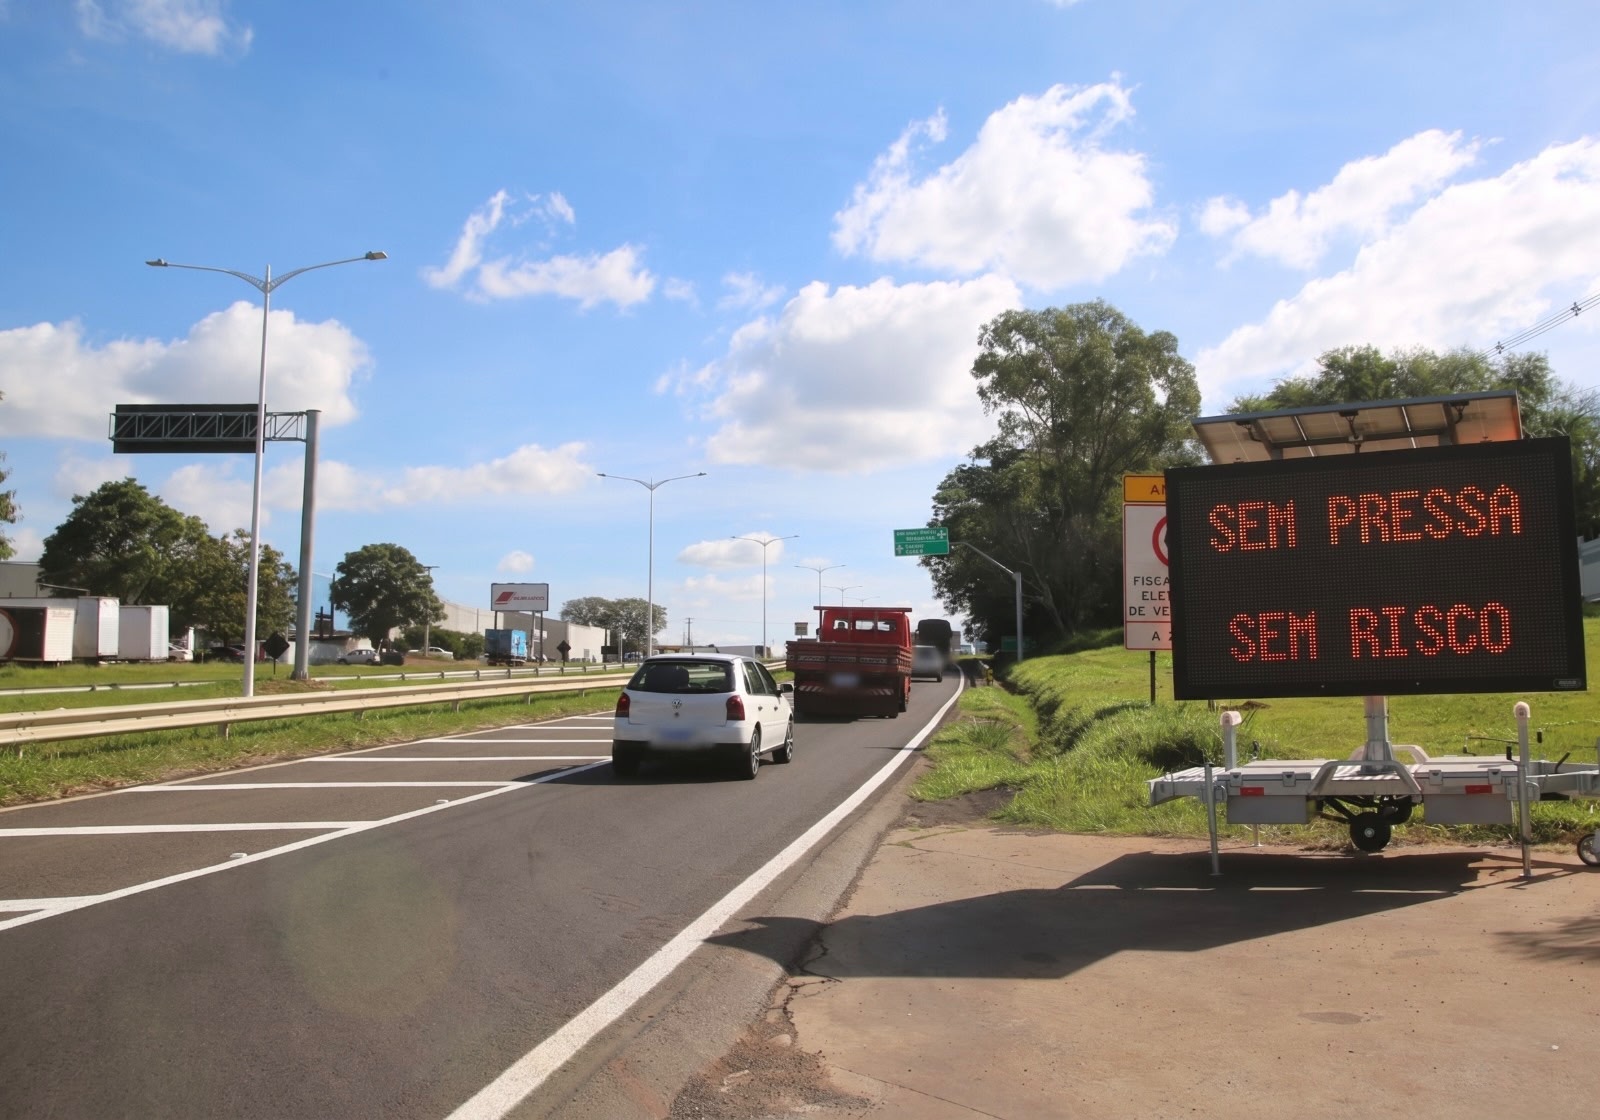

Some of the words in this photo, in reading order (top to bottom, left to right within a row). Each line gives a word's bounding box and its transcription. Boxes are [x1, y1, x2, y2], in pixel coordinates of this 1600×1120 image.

[1209, 500, 1296, 552] SEM
[1328, 484, 1521, 545] PRESSA
[1129, 606, 1146, 616] DE
[1151, 631, 1161, 641] A
[1229, 611, 1317, 662] SEM
[1350, 602, 1511, 658] RISCO
